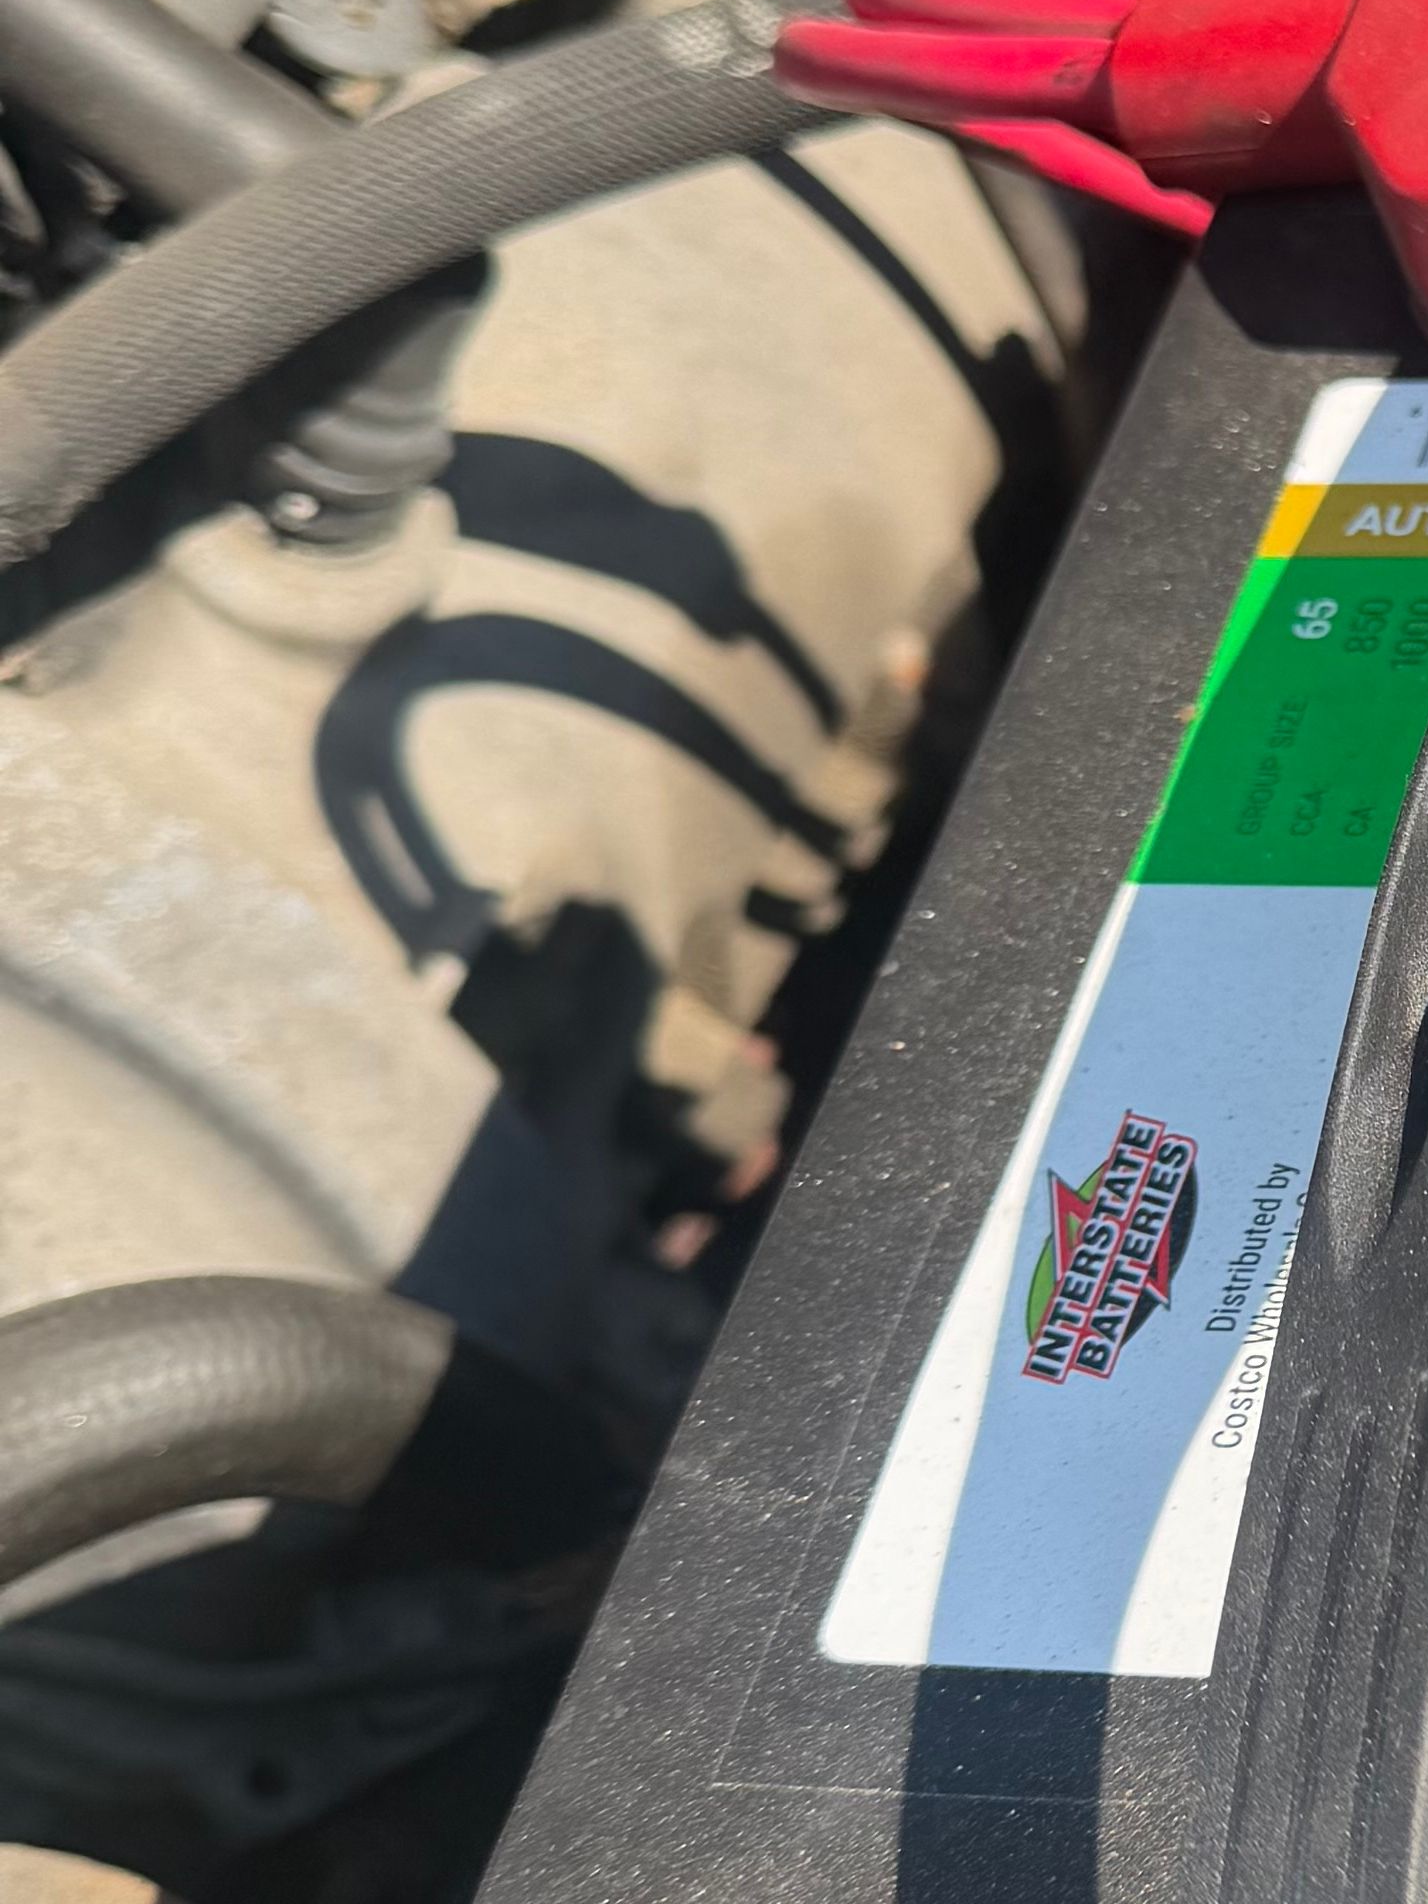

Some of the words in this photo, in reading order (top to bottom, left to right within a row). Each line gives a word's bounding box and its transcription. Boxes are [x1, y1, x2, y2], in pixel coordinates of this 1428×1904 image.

[1292, 598, 1339, 639] 65
[1343, 598, 1394, 653] 850
[1028, 1120, 1156, 1376] INTERSTATE
[1077, 1142, 1191, 1371] BATTERIES
[1204, 1198, 1282, 1331] Distributed
[1256, 1163, 1300, 1189] by
[1211, 1354, 1266, 1447] Costco
